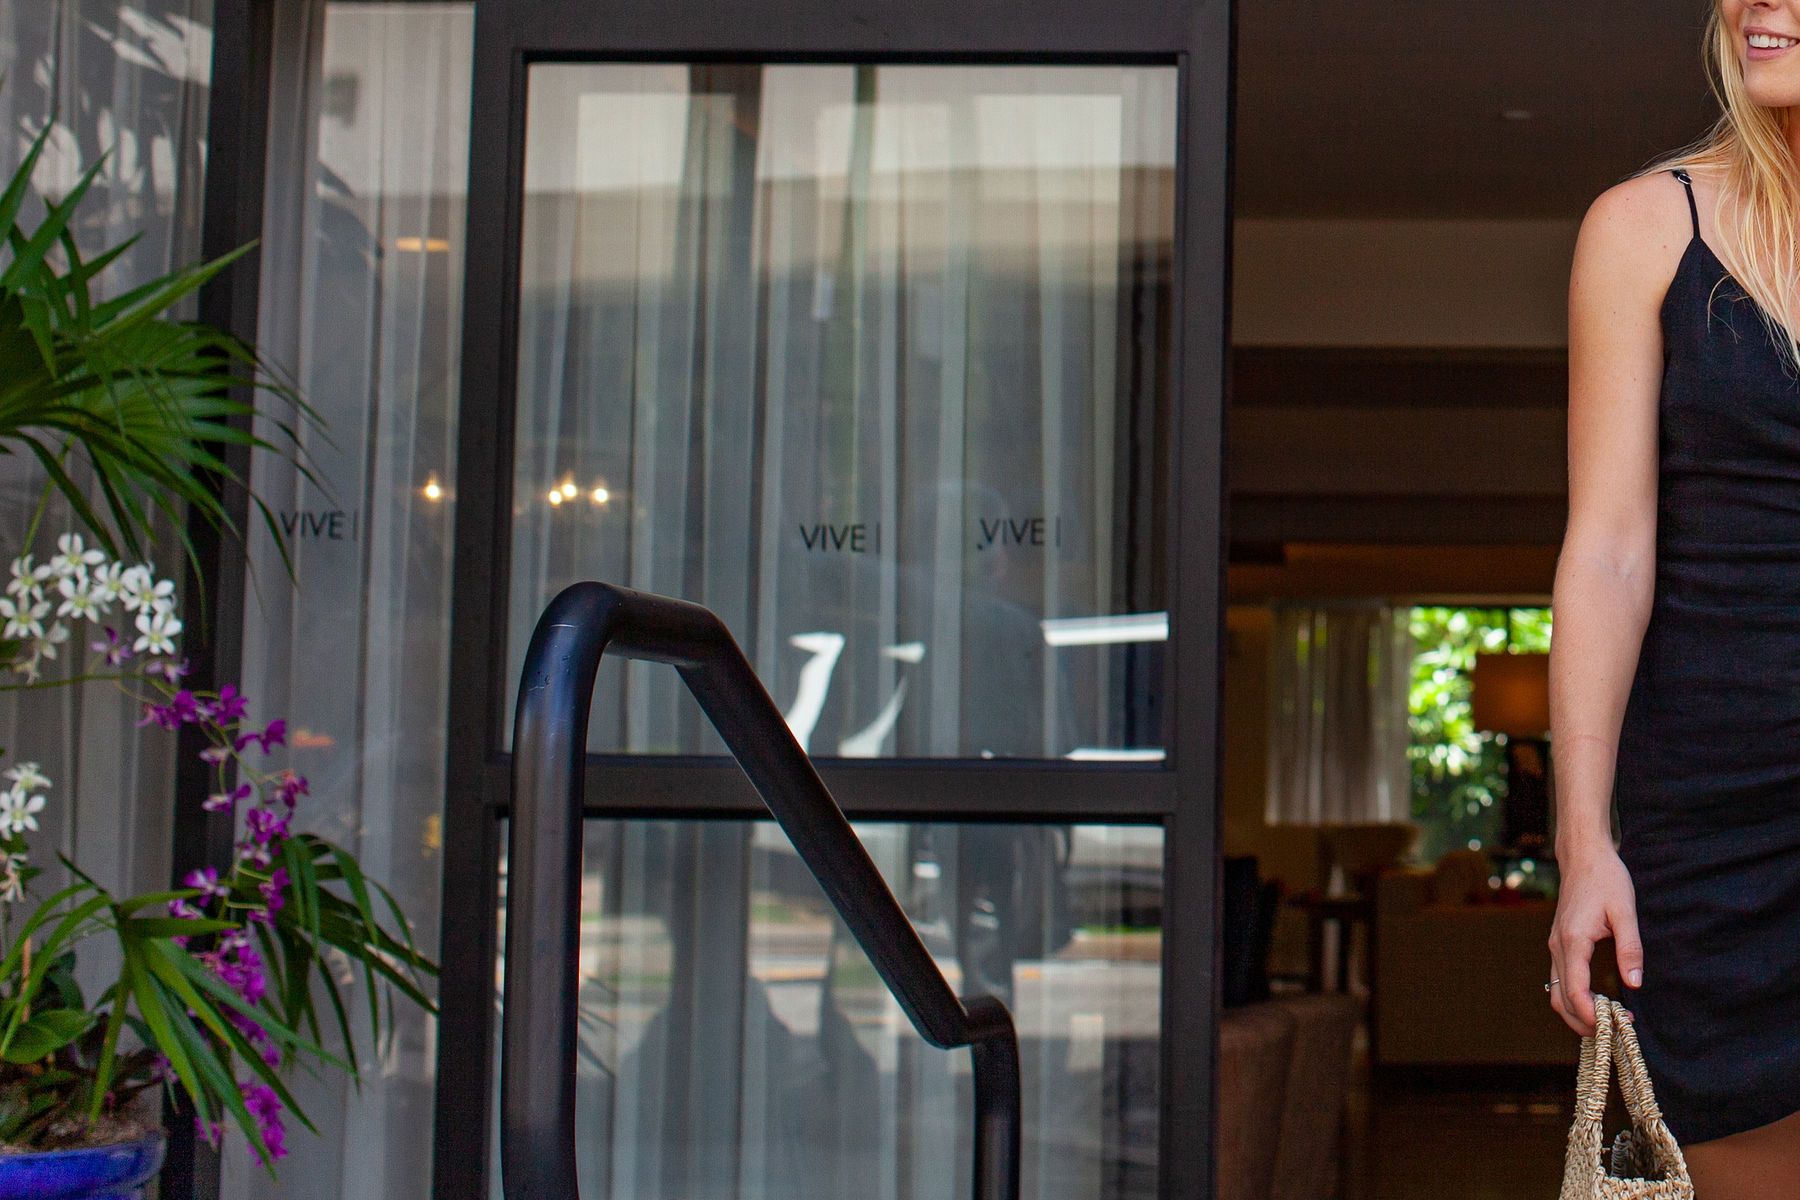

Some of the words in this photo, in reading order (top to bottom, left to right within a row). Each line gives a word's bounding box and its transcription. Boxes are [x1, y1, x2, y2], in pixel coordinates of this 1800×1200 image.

[280, 511, 343, 541] VIVE
[800, 524, 866, 552] VIVE
[980, 517, 1045, 546] VIVE
